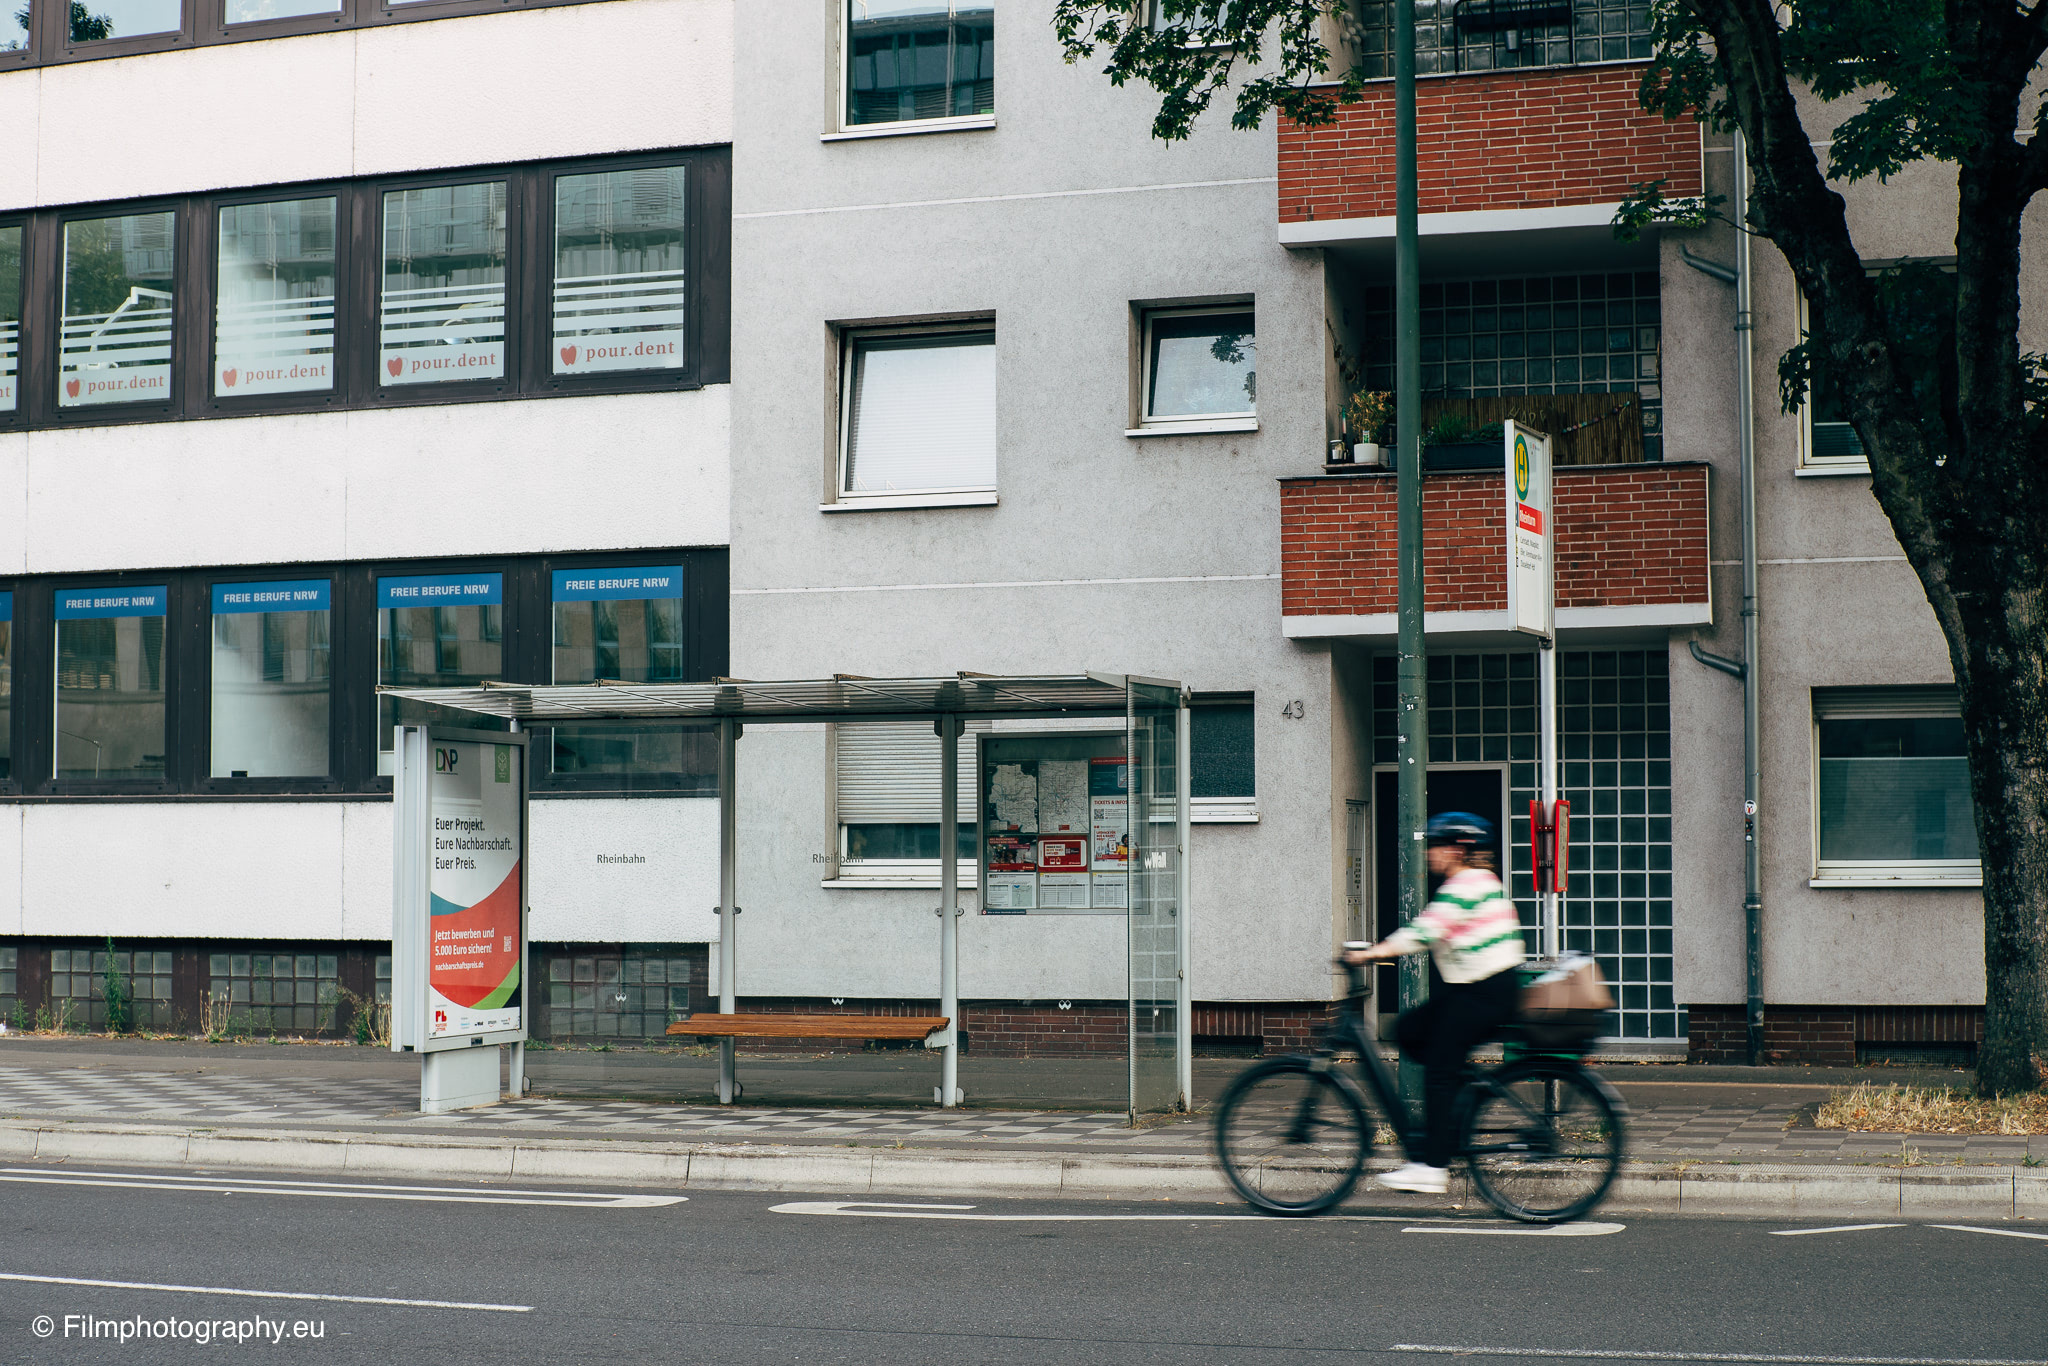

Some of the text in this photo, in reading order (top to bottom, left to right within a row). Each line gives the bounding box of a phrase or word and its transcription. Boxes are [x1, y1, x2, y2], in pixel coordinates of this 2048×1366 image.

[586, 341, 675, 362] pour.dent
[411, 353, 496, 374] pour.dent
[245, 364, 326, 385] pour.dent
[88, 375, 164, 395] pour.dent
[390, 584, 489, 597] FREIE BERUFE NRW
[565, 577, 670, 590] FREIE BERUFE NRW
[66, 596, 155, 609] FREIE BERUFE NRW
[223, 590, 318, 603] FREIE BERUFE NRW
[1281, 700, 1305, 720] 43
[435, 748, 459, 772] DNP
[435, 817, 486, 834] Euer Projekt.
[435, 836, 513, 851] Eure Nachbarschaft.
[435, 856, 477, 870] Euer Preis.
[596, 853, 646, 864] Rheinbahn
[434, 927, 495, 943] Jetzt bewerben und
[434, 942, 493, 956] 5.000 Euro sichern!
